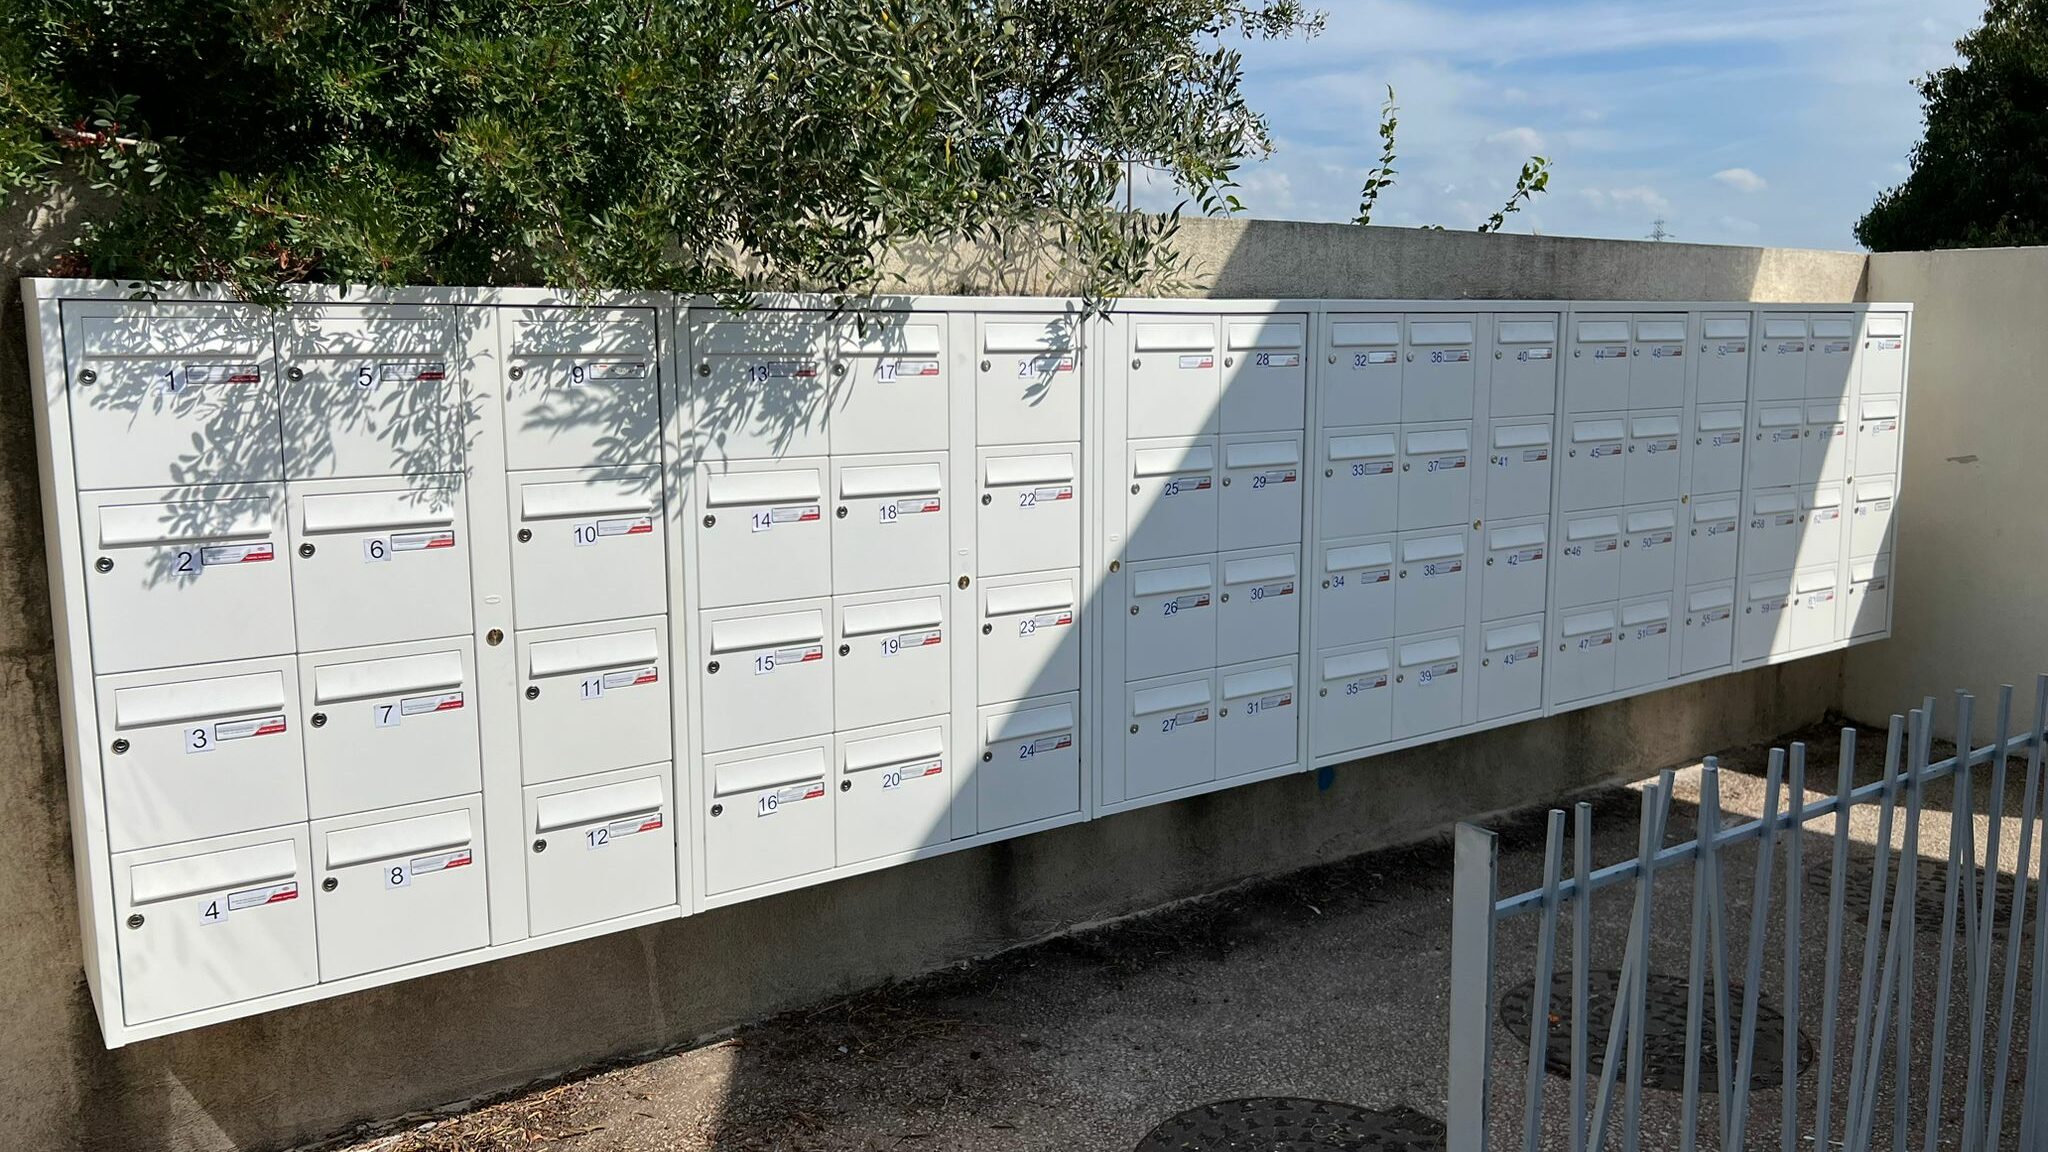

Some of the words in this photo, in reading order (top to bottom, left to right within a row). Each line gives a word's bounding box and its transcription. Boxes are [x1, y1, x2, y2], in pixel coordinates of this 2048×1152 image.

[1256, 353, 1269, 365] 28
[1431, 351, 1442, 363] 36
[1517, 351, 1527, 362] 40
[1594, 349, 1604, 359] 44
[1652, 348, 1661, 358] 48
[1354, 354, 1366, 367] 32
[572, 366, 584, 384] 9
[748, 366, 768, 382] 13
[879, 364, 894, 379] 17
[1019, 362, 1033, 376] 21
[165, 370, 175, 390] 1
[359, 367, 373, 386] 5
[1590, 448, 1600, 458] 45
[1647, 444, 1657, 454] 49
[1427, 461, 1438, 472] 37
[1498, 457, 1508, 466] 41
[1352, 464, 1364, 476] 33
[1164, 482, 1179, 496] 25
[1253, 476, 1266, 488] 29
[1020, 492, 1035, 507] 22
[880, 505, 897, 520] 18
[752, 513, 771, 528] 14
[574, 526, 596, 543] 10
[370, 540, 384, 559] 6
[1642, 538, 1652, 547] 50
[1571, 546, 1581, 556] 46
[178, 551, 193, 572] 2
[1507, 554, 1518, 565] 42
[1424, 564, 1435, 576] 38
[1333, 575, 1344, 587] 34
[1250, 587, 1264, 600] 30
[1164, 601, 1178, 615] 26
[1020, 620, 1036, 634] 23
[1637, 629, 1646, 639] 51
[881, 639, 898, 654] 19
[1579, 639, 1588, 649] 47
[755, 656, 774, 671] 15
[1503, 654, 1514, 665] 43
[1420, 670, 1432, 682] 39
[581, 680, 600, 697] 11
[1346, 683, 1358, 695] 35
[380, 705, 393, 723] 7
[1247, 702, 1258, 714] 31
[1162, 718, 1175, 732] 27
[192, 729, 207, 748] 3
[1020, 744, 1035, 758] 24
[883, 772, 900, 788] 20
[759, 795, 777, 811] 16
[587, 829, 608, 846] 12
[390, 866, 403, 885] 8
[204, 901, 220, 920] 4
